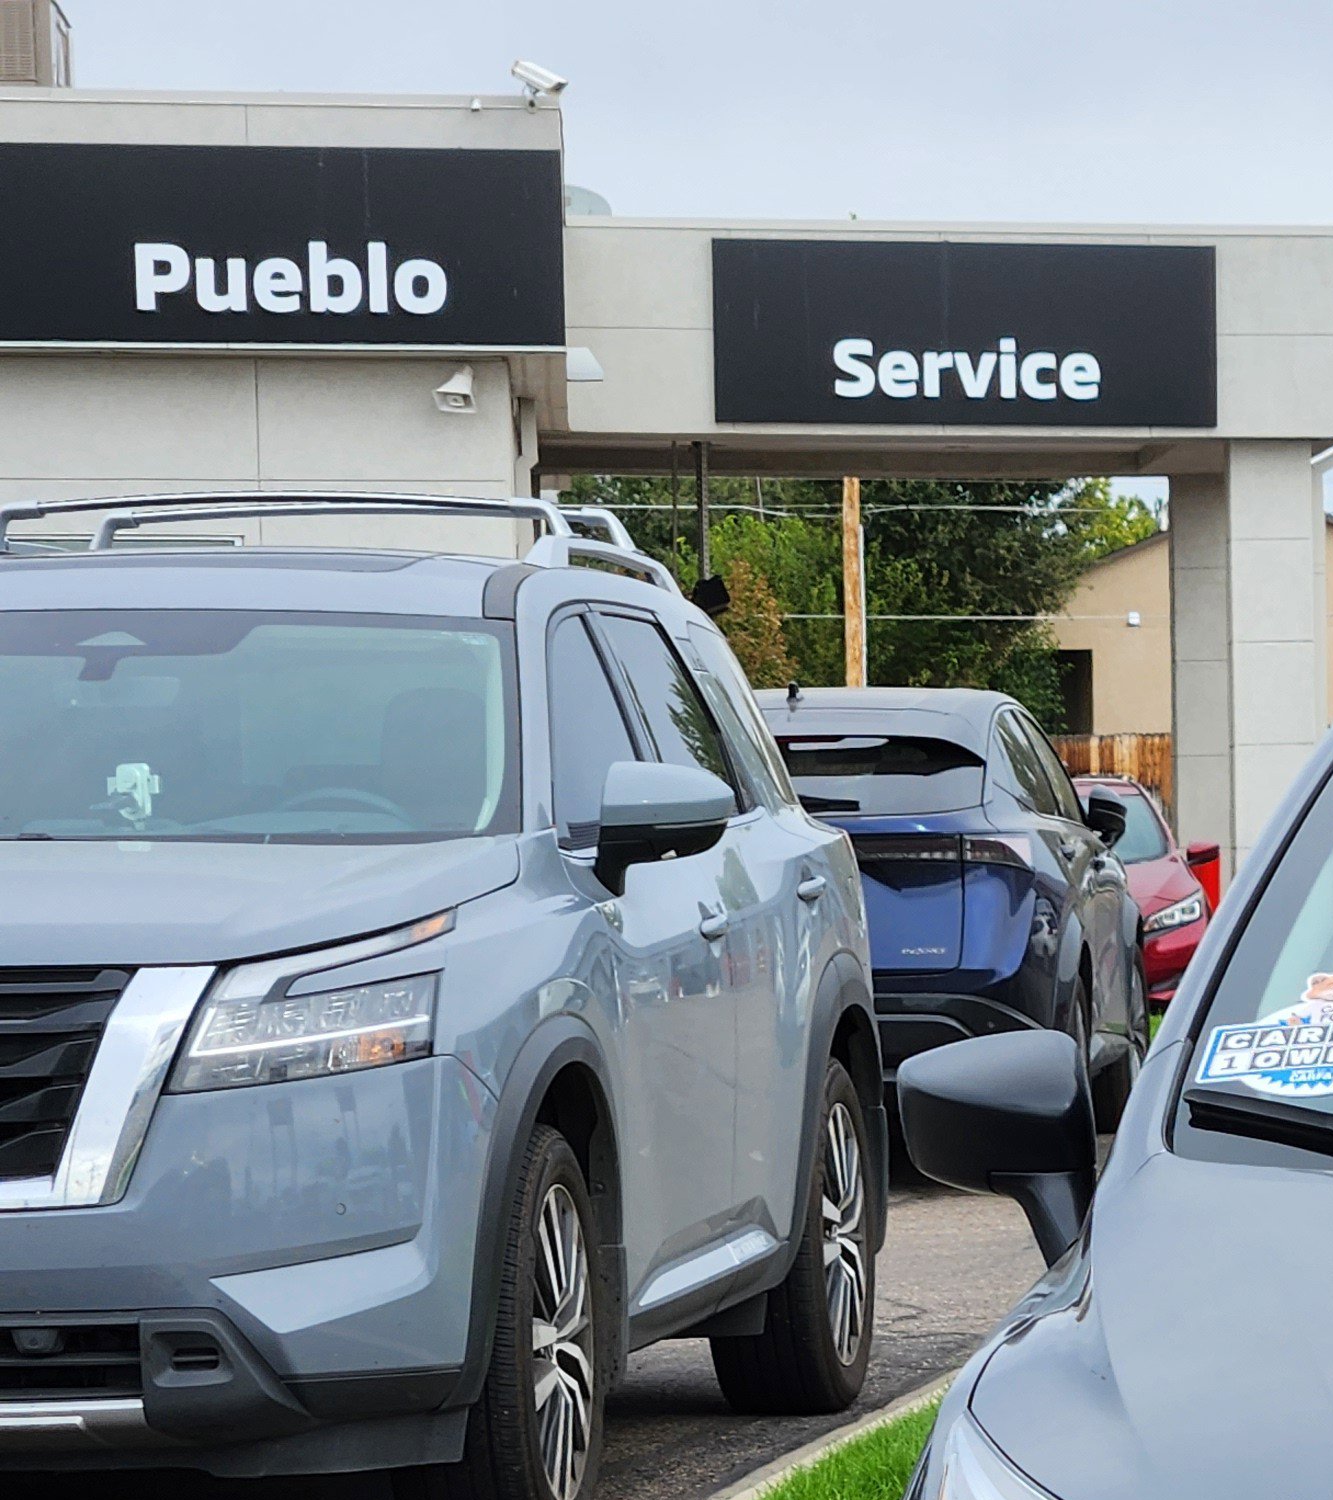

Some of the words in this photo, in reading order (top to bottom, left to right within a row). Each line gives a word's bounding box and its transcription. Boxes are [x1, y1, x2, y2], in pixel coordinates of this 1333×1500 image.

[134, 240, 448, 314] Pueblo
[833, 337, 1101, 400] Service
[1220, 1057, 1239, 1070] 1
